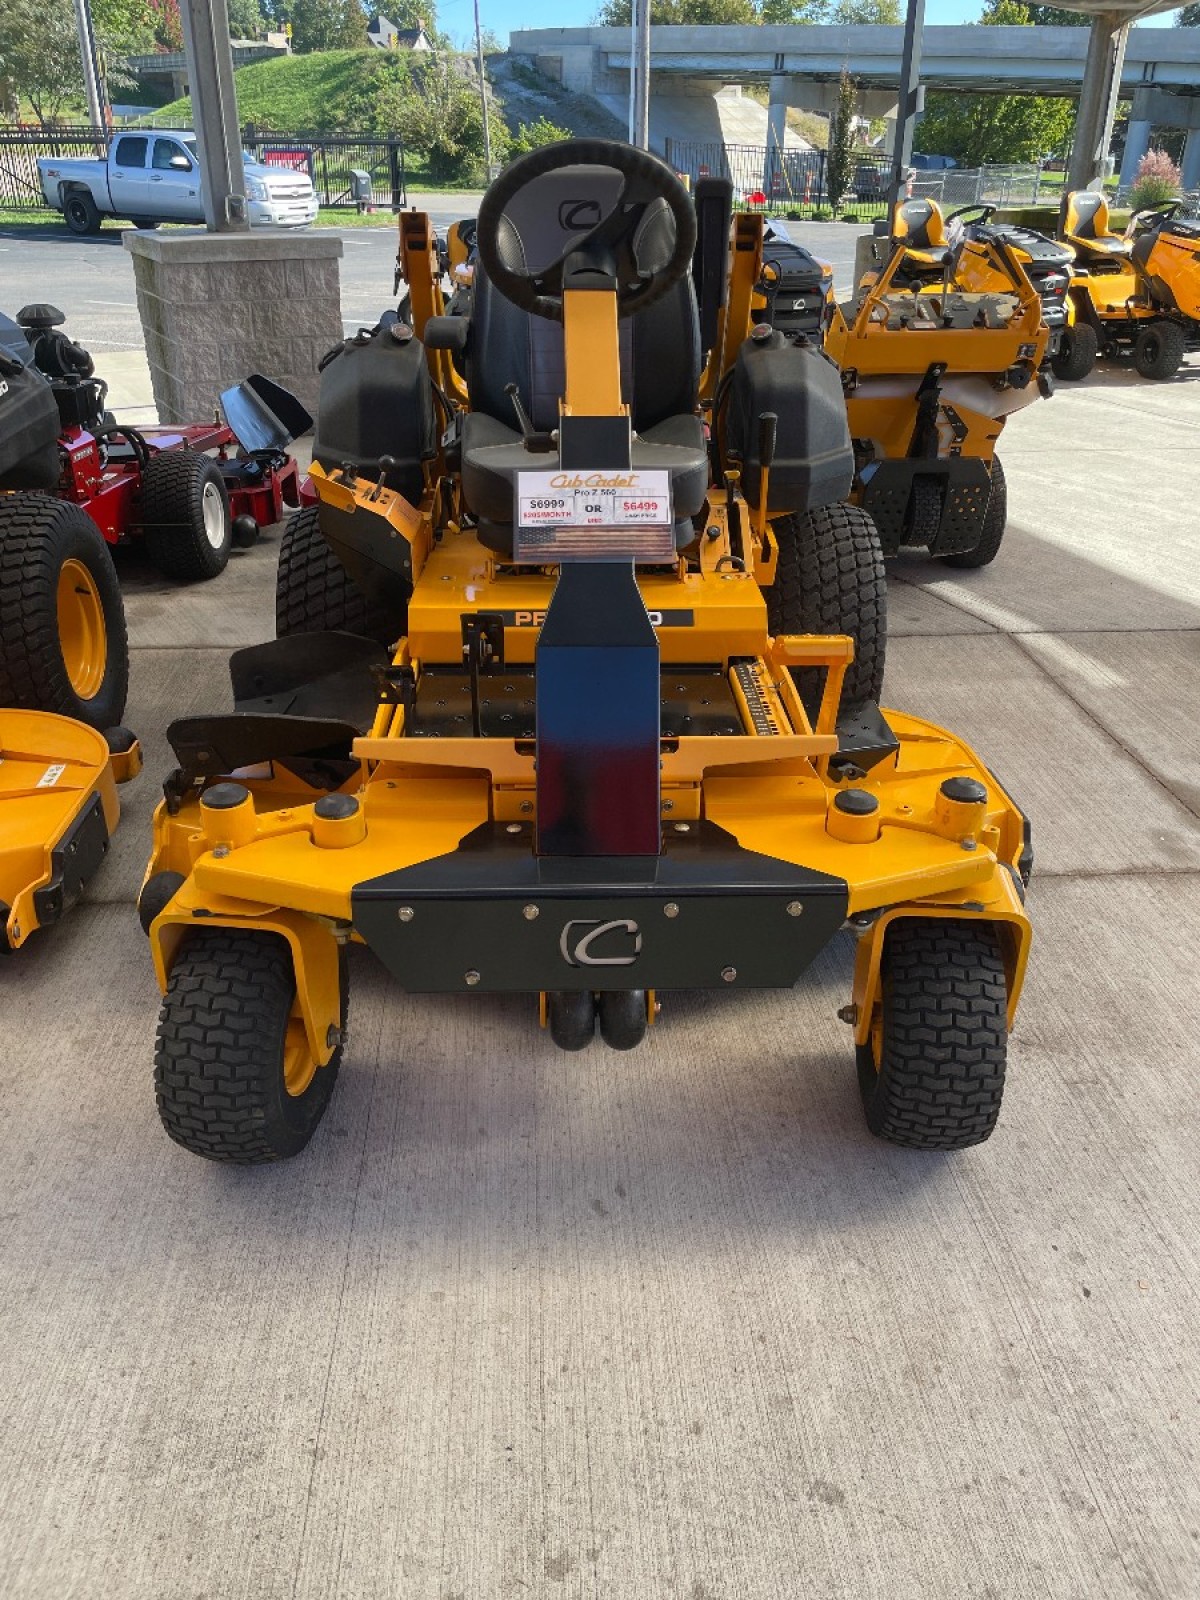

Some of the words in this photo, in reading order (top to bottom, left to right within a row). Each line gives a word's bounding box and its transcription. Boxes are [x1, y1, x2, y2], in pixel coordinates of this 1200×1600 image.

[550, 474, 582, 489] Cub
[585, 474, 641, 489] Cadet
[574, 488, 590, 496] Pro
[591, 488, 598, 496] Z
[530, 499, 565, 509] $6999
[585, 504, 602, 513] OR
[623, 502, 658, 511] $6499
